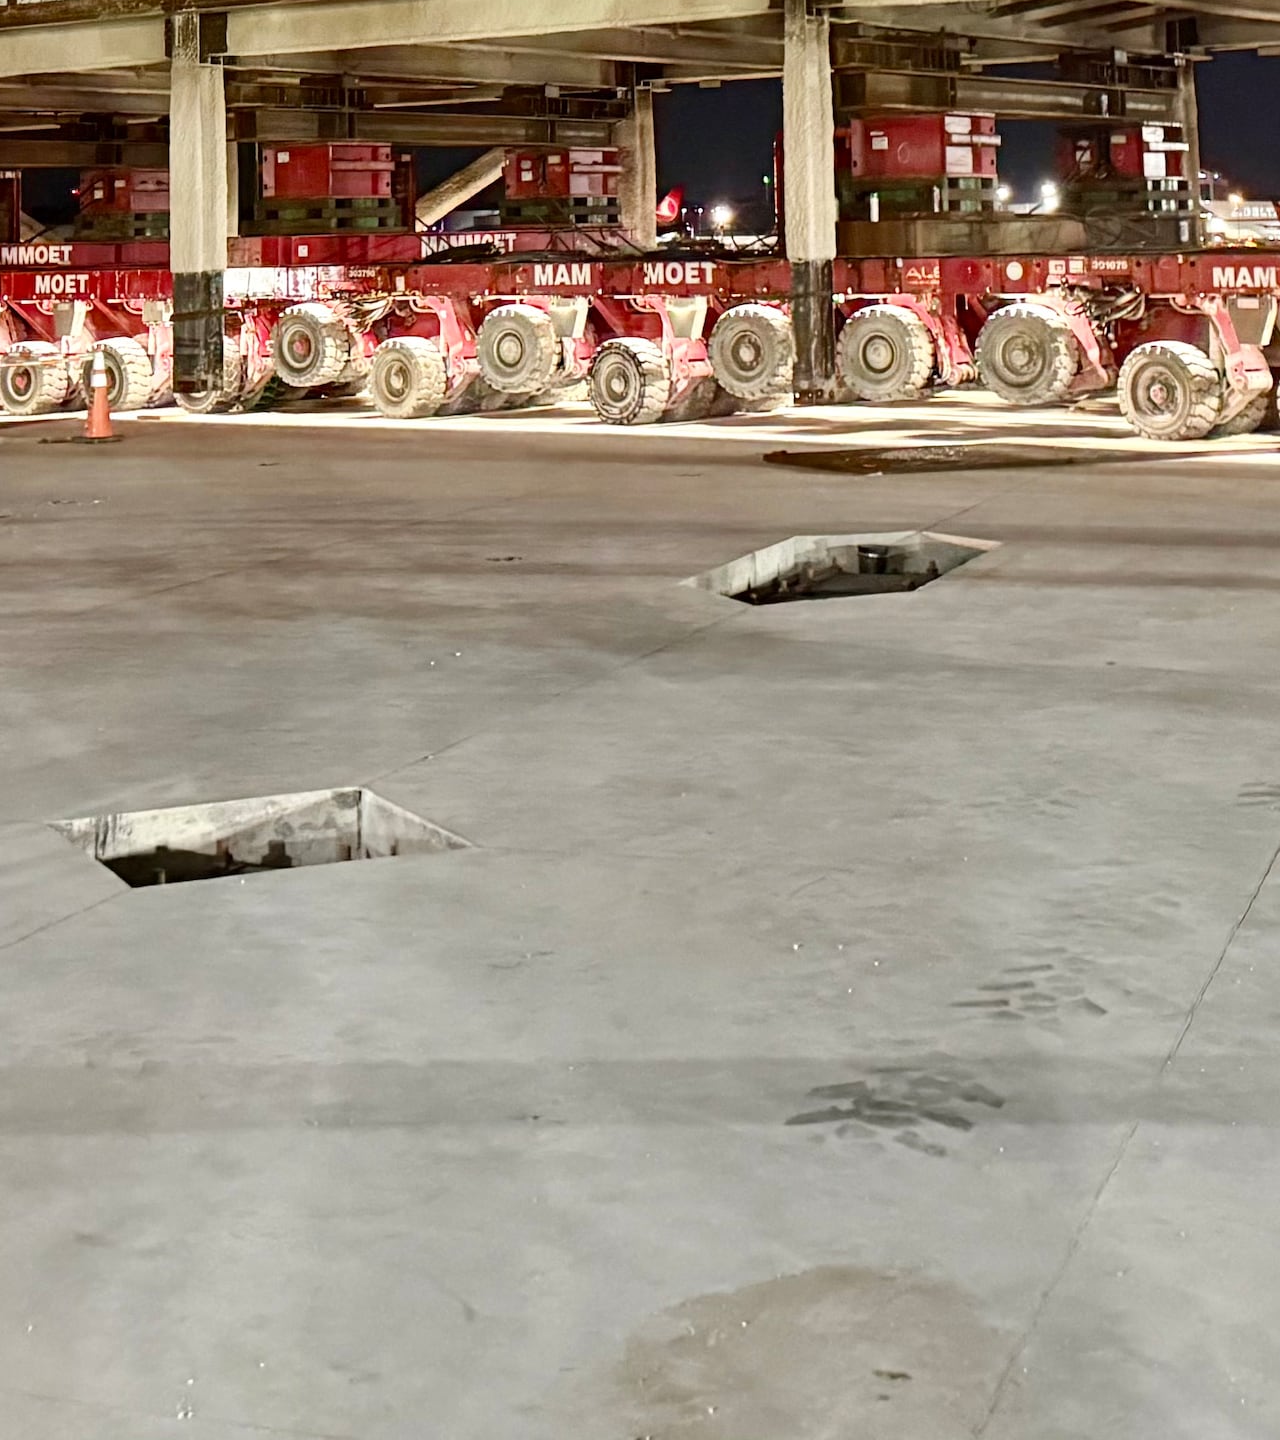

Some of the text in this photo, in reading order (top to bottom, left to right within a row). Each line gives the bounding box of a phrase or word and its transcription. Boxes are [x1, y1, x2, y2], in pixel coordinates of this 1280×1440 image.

[35, 273, 90, 295] MOET
[534, 261, 717, 287] MAM MOET
[1212, 266, 1278, 289] MAM
